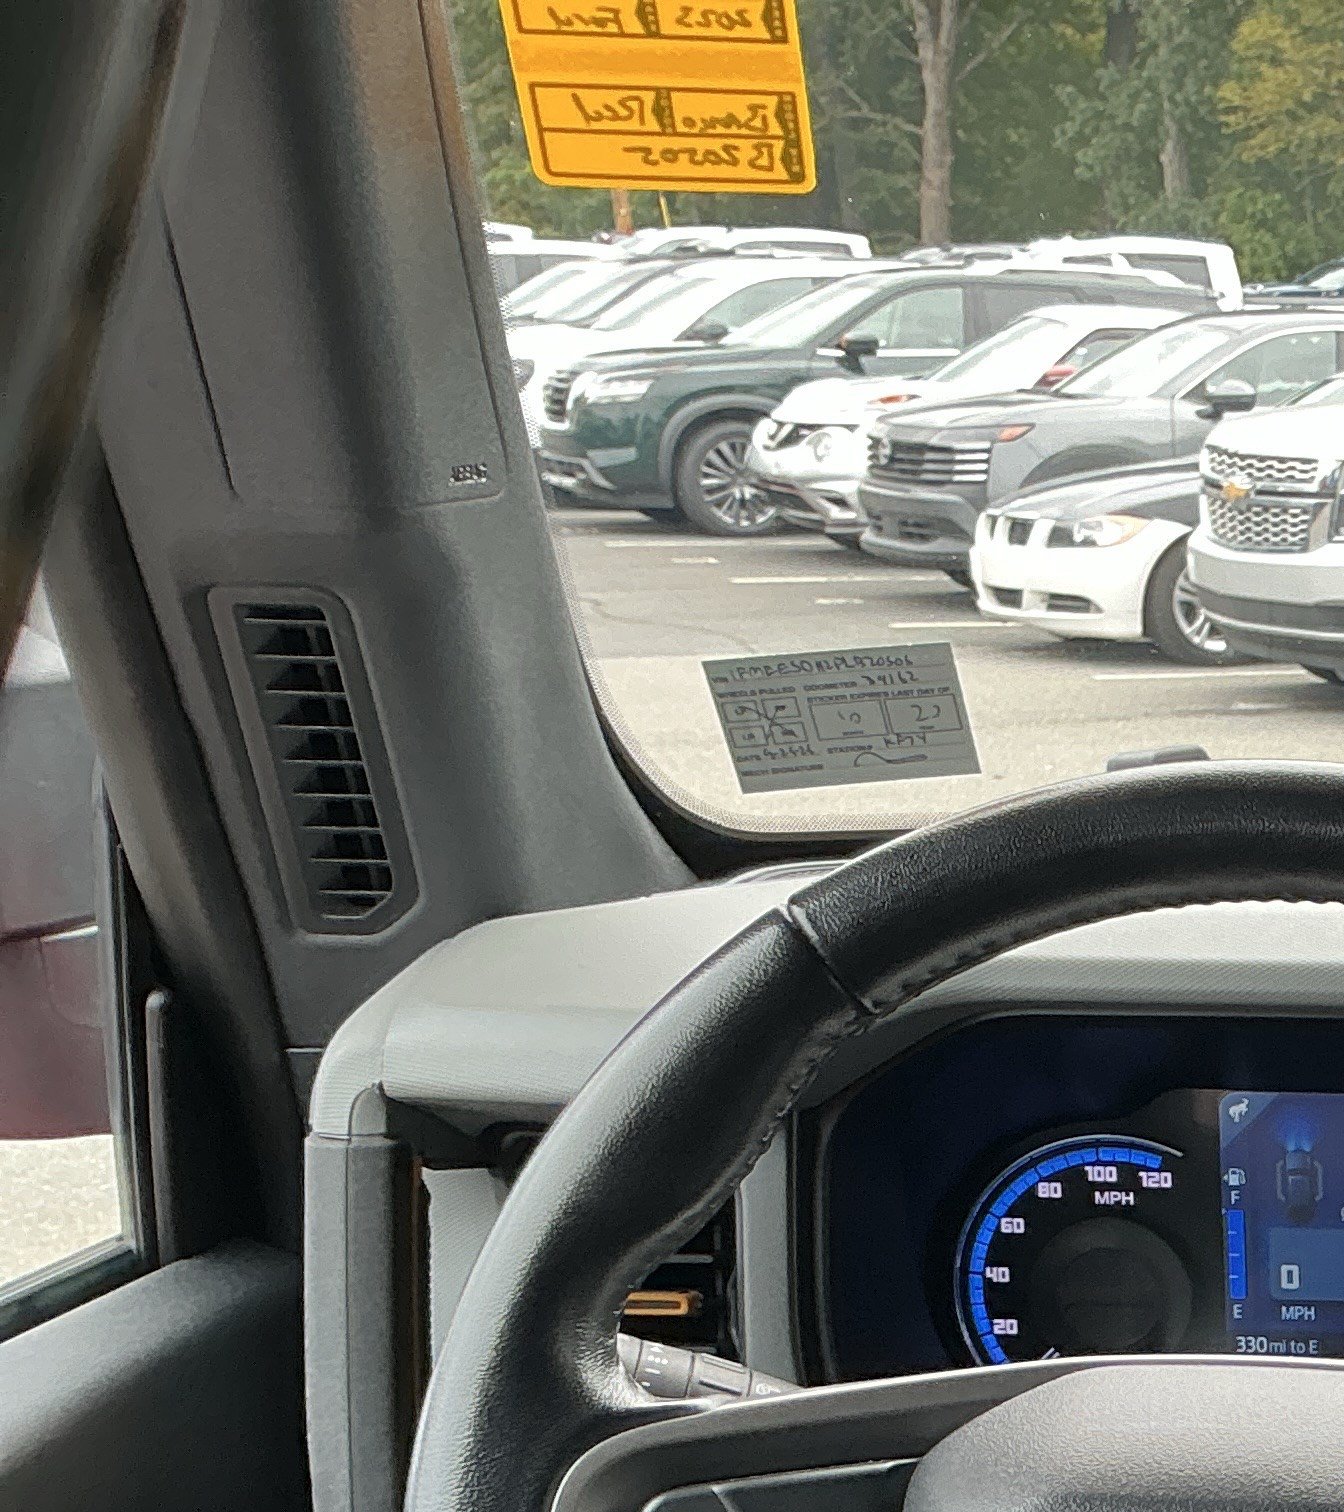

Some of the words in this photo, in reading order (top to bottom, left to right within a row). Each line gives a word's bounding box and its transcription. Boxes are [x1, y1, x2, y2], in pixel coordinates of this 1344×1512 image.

[1084, 1165, 1117, 1182] 100
[1138, 1171, 1172, 1188] 120
[1037, 1182, 1062, 1199] 80
[1094, 1191, 1135, 1206] MPH
[1231, 1190, 1240, 1205] F
[1000, 1217, 1025, 1234] 60
[985, 1266, 1010, 1283] 40
[1280, 1264, 1300, 1290] 0
[1233, 1304, 1242, 1319] E
[1281, 1305, 1316, 1321] MPH
[993, 1319, 1018, 1335] 20
[1291, 1340, 1306, 1354] to
[1309, 1340, 1319, 1354] E
